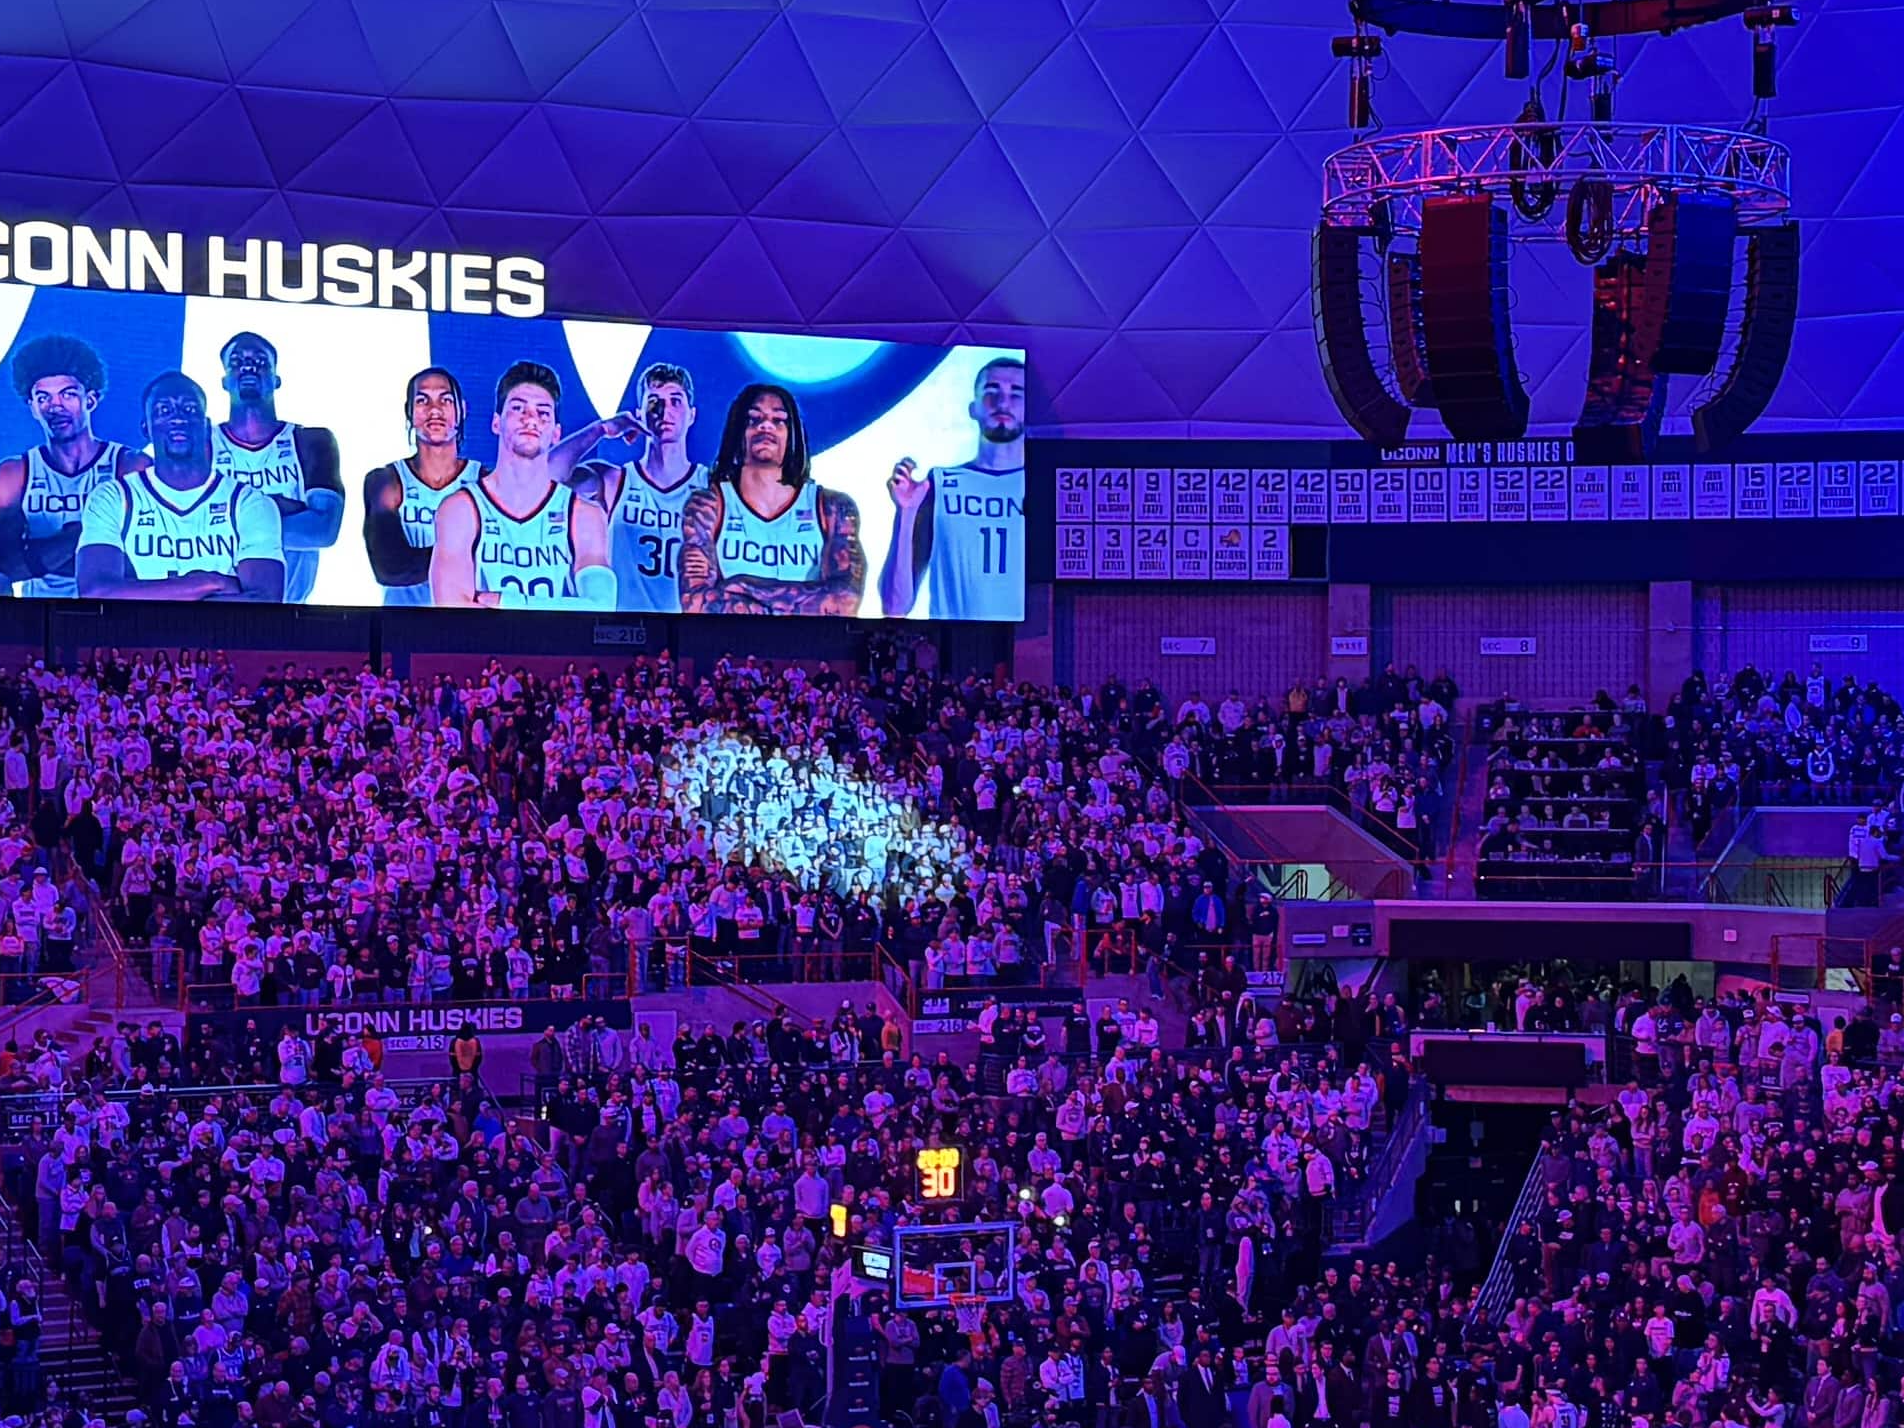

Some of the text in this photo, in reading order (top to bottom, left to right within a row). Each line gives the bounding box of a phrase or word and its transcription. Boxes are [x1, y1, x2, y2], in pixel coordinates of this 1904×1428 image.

[208, 235, 546, 318] HUSKIES
[1447, 441, 1491, 464] MEN'S
[1497, 440, 1559, 464] HUSKIES
[1060, 472, 1088, 491] 34
[1098, 473, 1128, 491] 44
[1146, 473, 1159, 491] 9
[1177, 473, 1207, 491] 32
[1216, 473, 1245, 491] 42
[1256, 473, 1285, 491] 42
[1296, 473, 1324, 491] 42
[1335, 473, 1363, 491] 50
[1374, 473, 1404, 491] 25
[1413, 472, 1443, 491] 00
[1460, 472, 1480, 491] 13
[1494, 472, 1524, 490] 52
[1534, 472, 1565, 490] 22
[1747, 467, 1766, 486] 15
[1779, 467, 1811, 486] 22
[1826, 466, 1849, 485] 13
[1863, 464, 1895, 484] 22
[134, 533, 235, 560] UCONN
[481, 540, 572, 568] UCONN
[721, 538, 819, 567] UCONN
[979, 528, 1007, 574] 11
[619, 628, 646, 642] 216
[1850, 637, 1860, 651] 9
[1199, 639, 1208, 652] 7
[1519, 639, 1529, 652] 8
[306, 1007, 523, 1036] UCONN HUSKIES
[938, 1018, 961, 1032] 216
[416, 1036, 442, 1050] 215
[922, 1169, 956, 1198] 30
